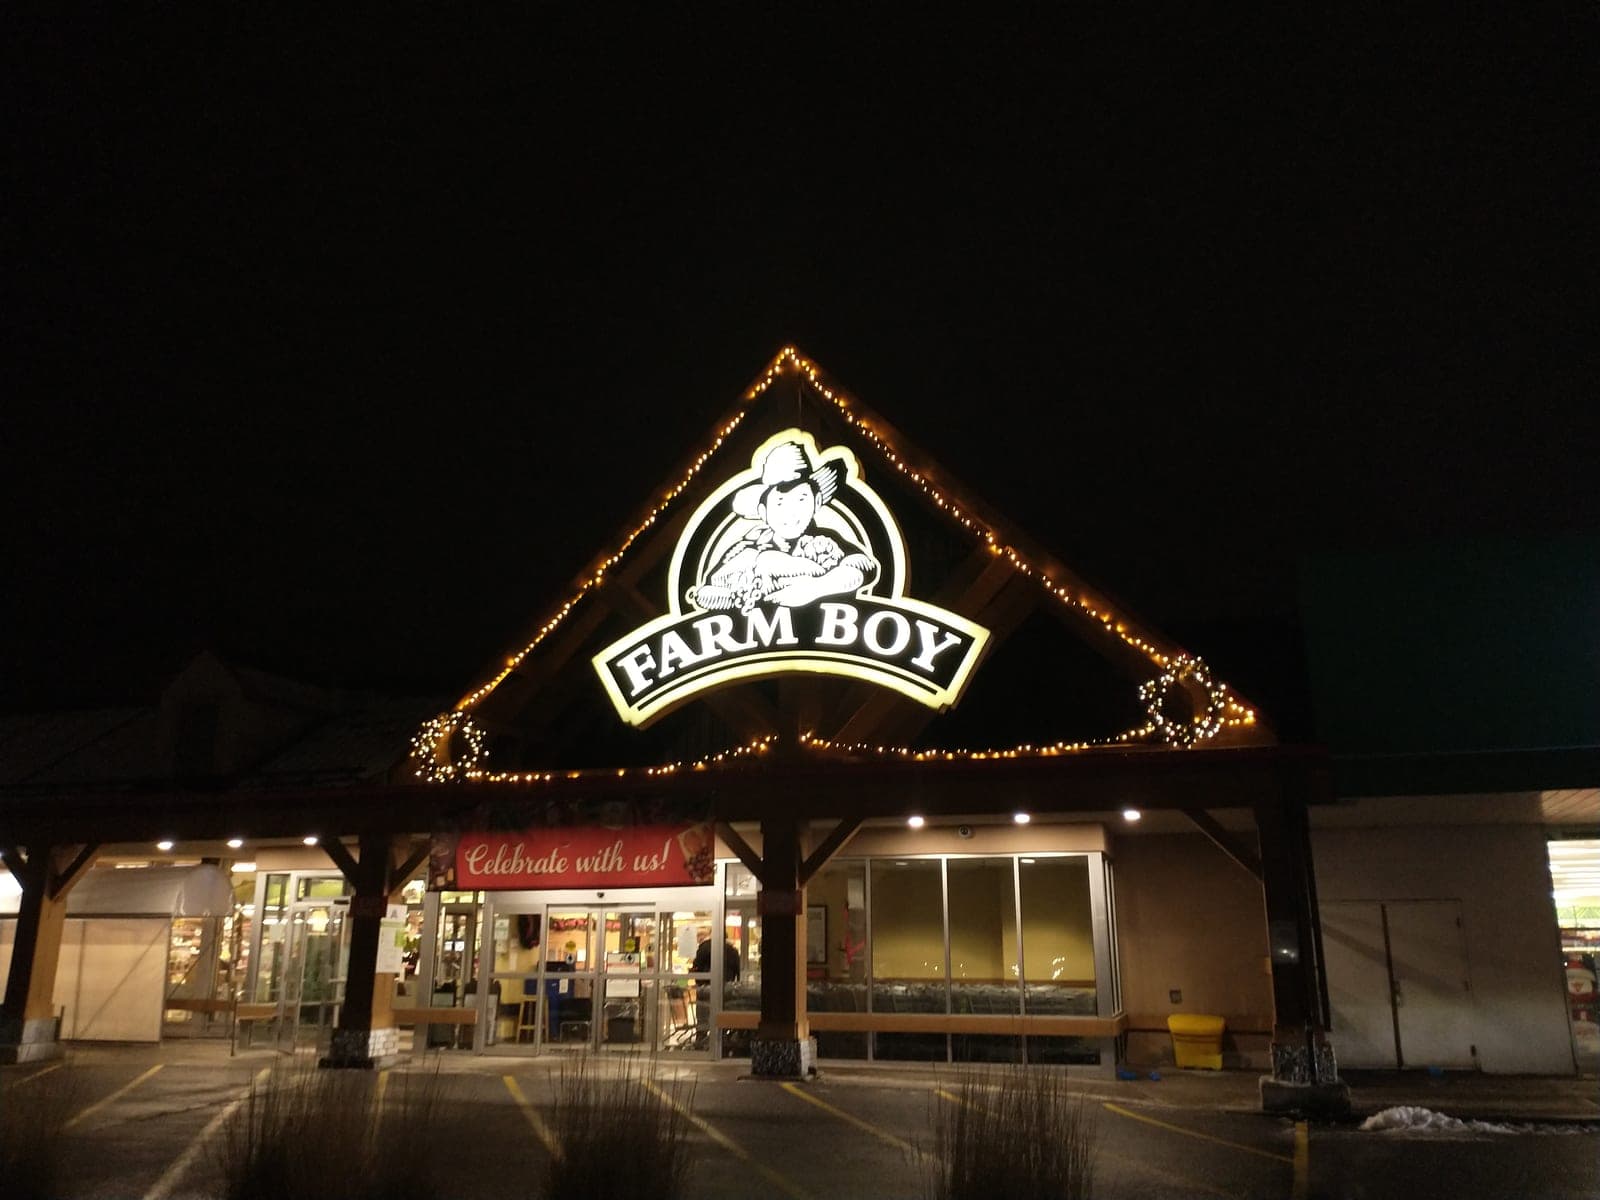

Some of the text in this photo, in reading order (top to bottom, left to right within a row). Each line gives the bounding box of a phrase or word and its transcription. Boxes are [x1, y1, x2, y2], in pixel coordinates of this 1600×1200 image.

[616, 603, 961, 696] FARM BOY
[464, 839, 672, 875] Celebrate with us!
